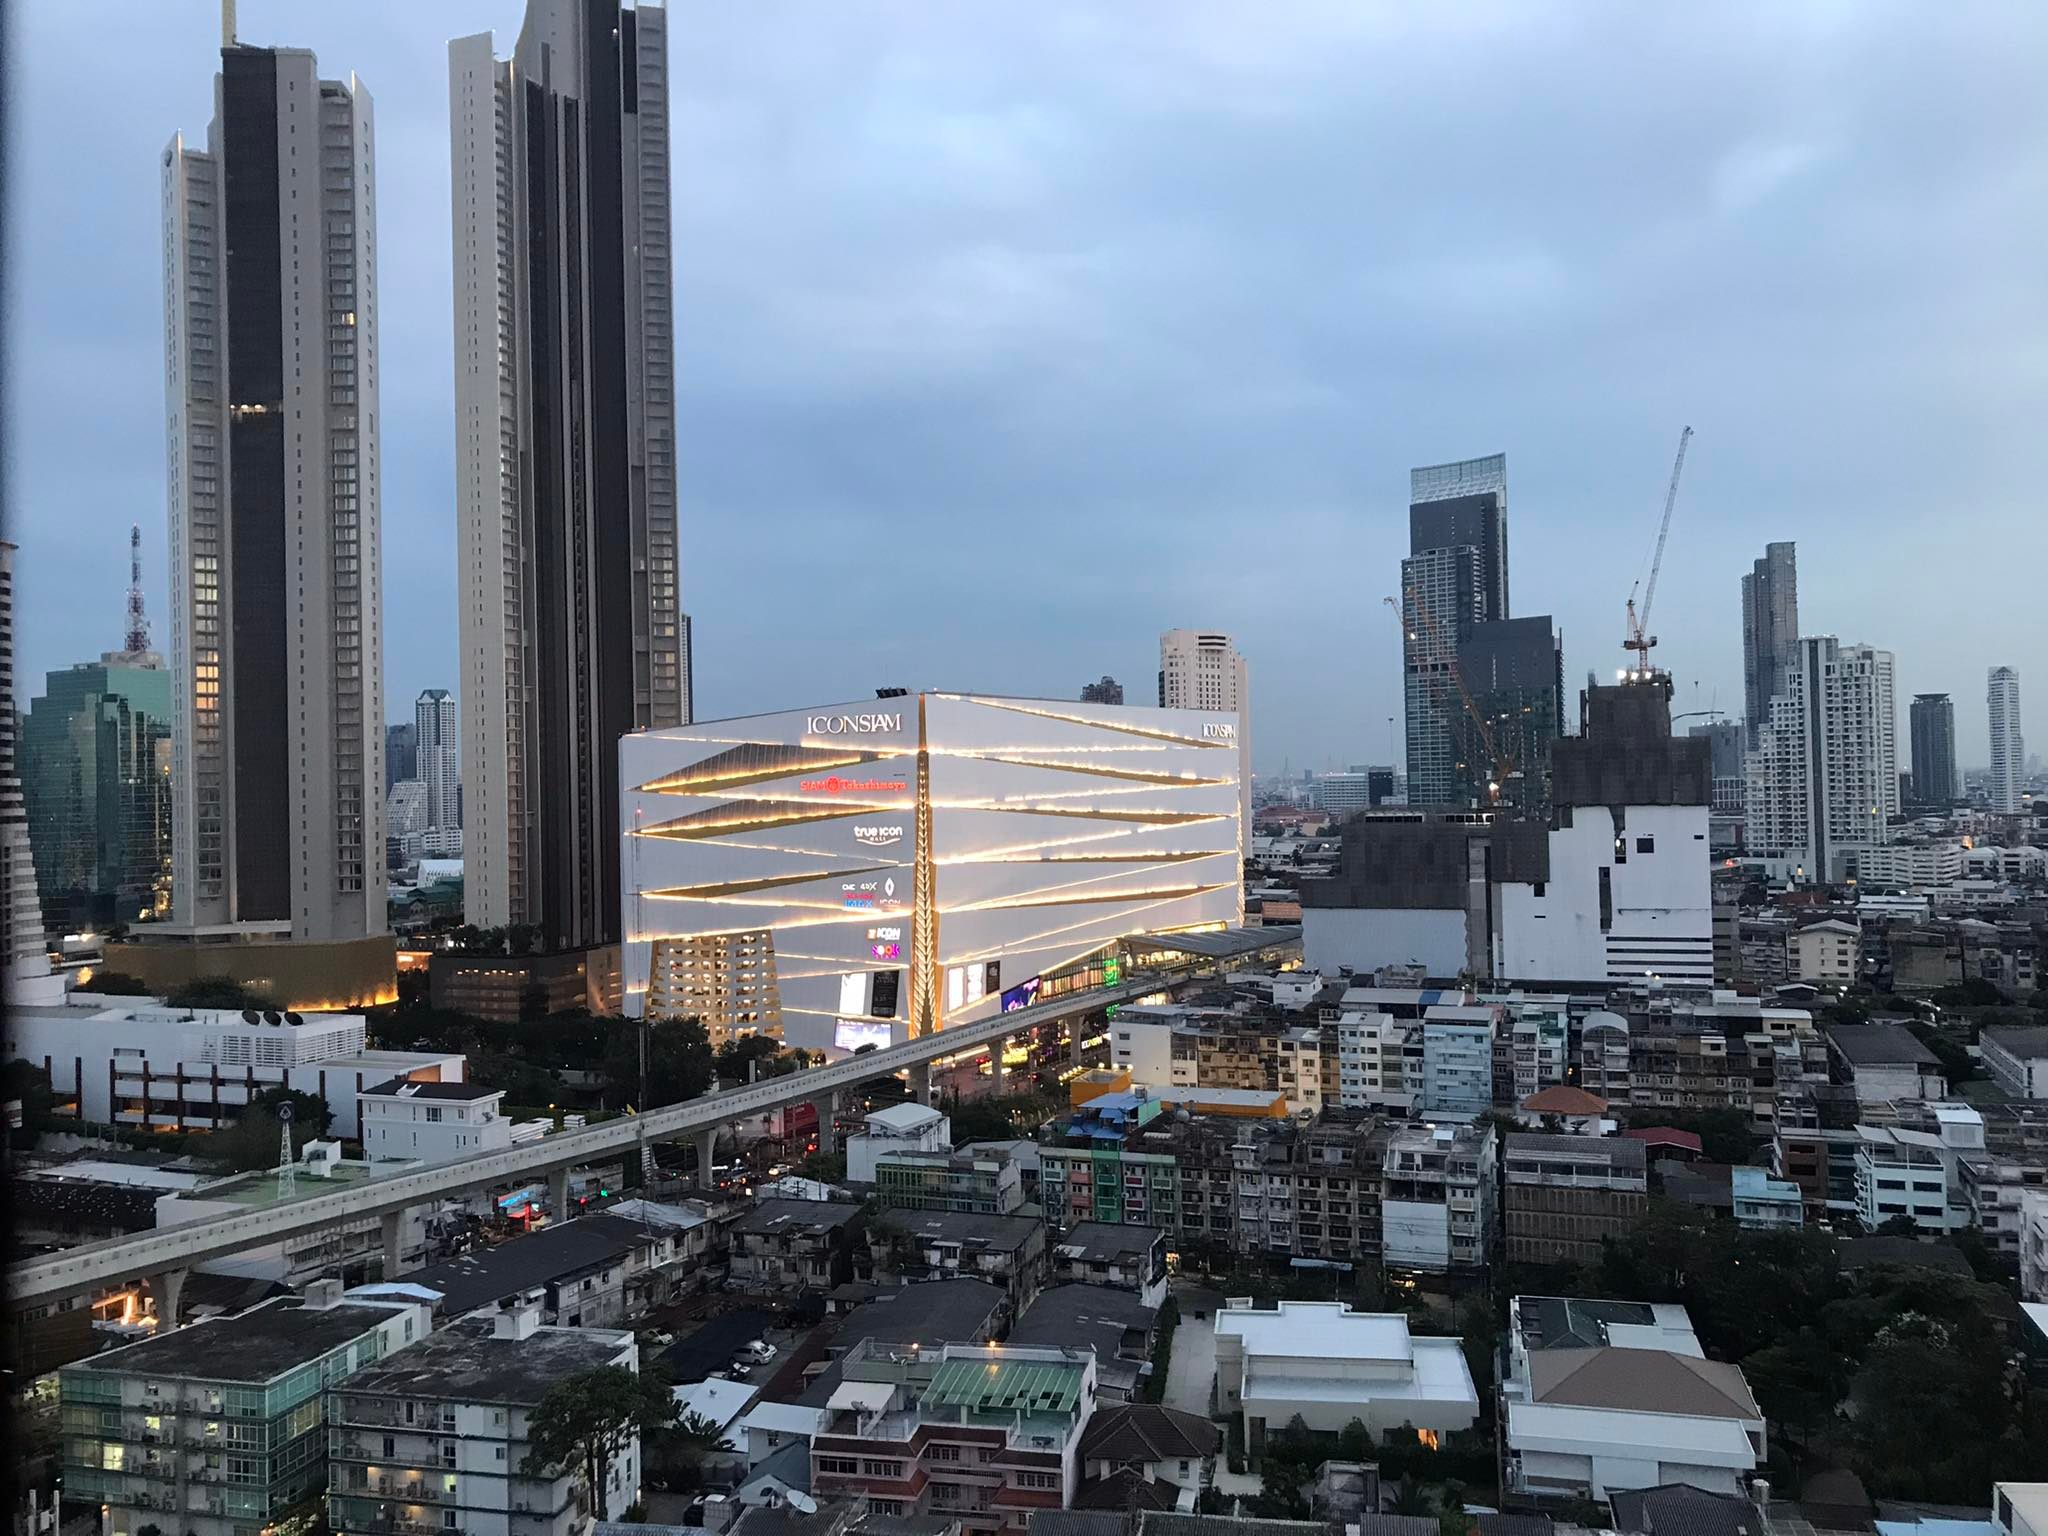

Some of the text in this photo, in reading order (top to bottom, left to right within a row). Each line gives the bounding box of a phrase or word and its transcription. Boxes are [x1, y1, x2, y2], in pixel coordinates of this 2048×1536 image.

[807, 713, 902, 735] ICONSIAM
[800, 778, 907, 793] SIAM Takashimaya
[853, 825, 878, 837] true
